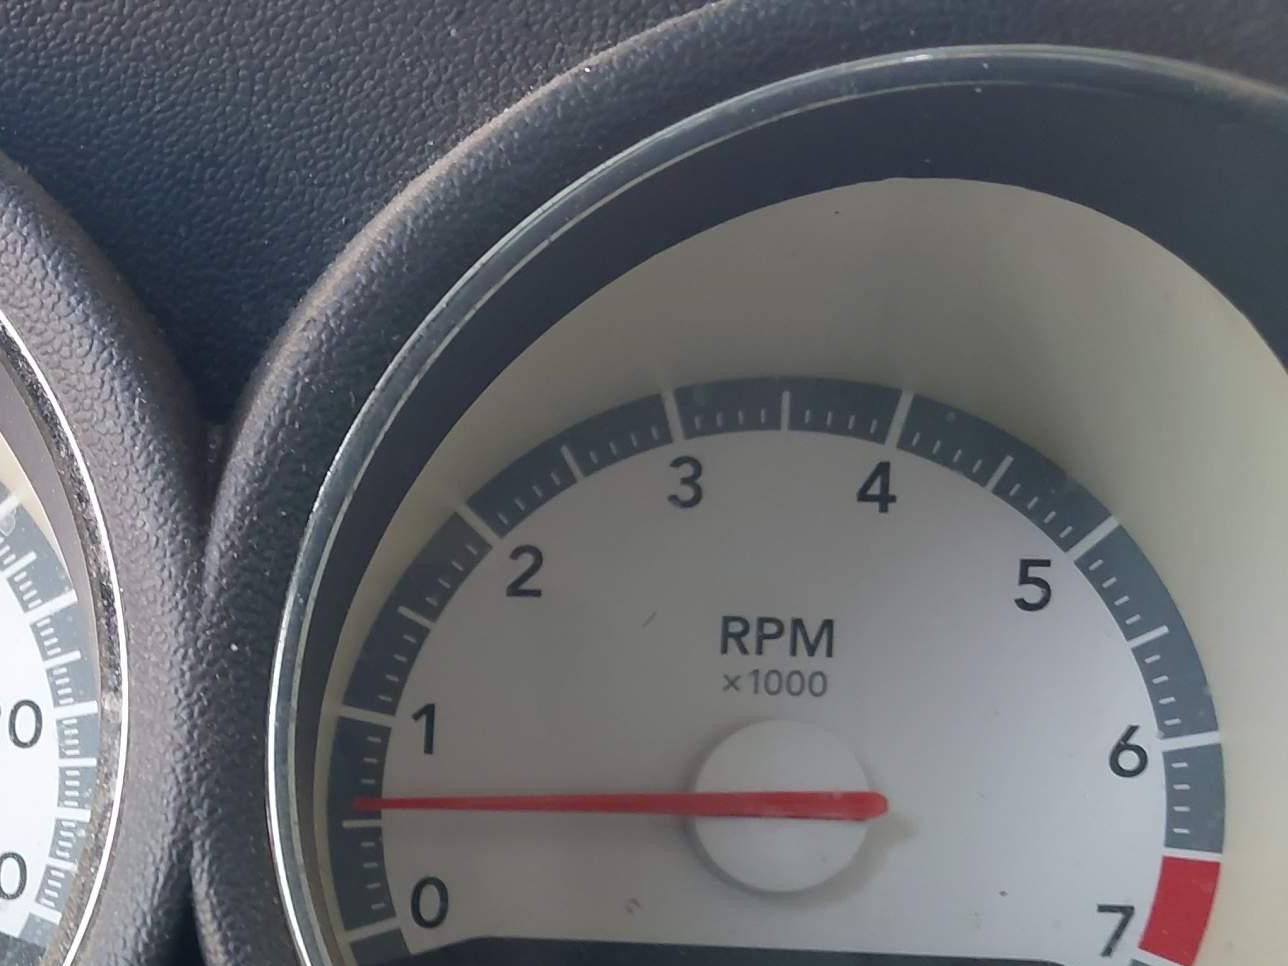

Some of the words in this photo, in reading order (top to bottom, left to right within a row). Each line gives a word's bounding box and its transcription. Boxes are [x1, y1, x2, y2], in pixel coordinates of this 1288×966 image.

[668, 456, 704, 509] 3
[857, 461, 897, 513] 4
[506, 545, 544, 598] 2
[1015, 558, 1053, 611] 5
[720, 616, 835, 658] RPM
[411, 704, 436, 755] 1
[1109, 726, 1148, 779] 6
[410, 876, 449, 928] 0
[1096, 904, 1135, 958] 7
